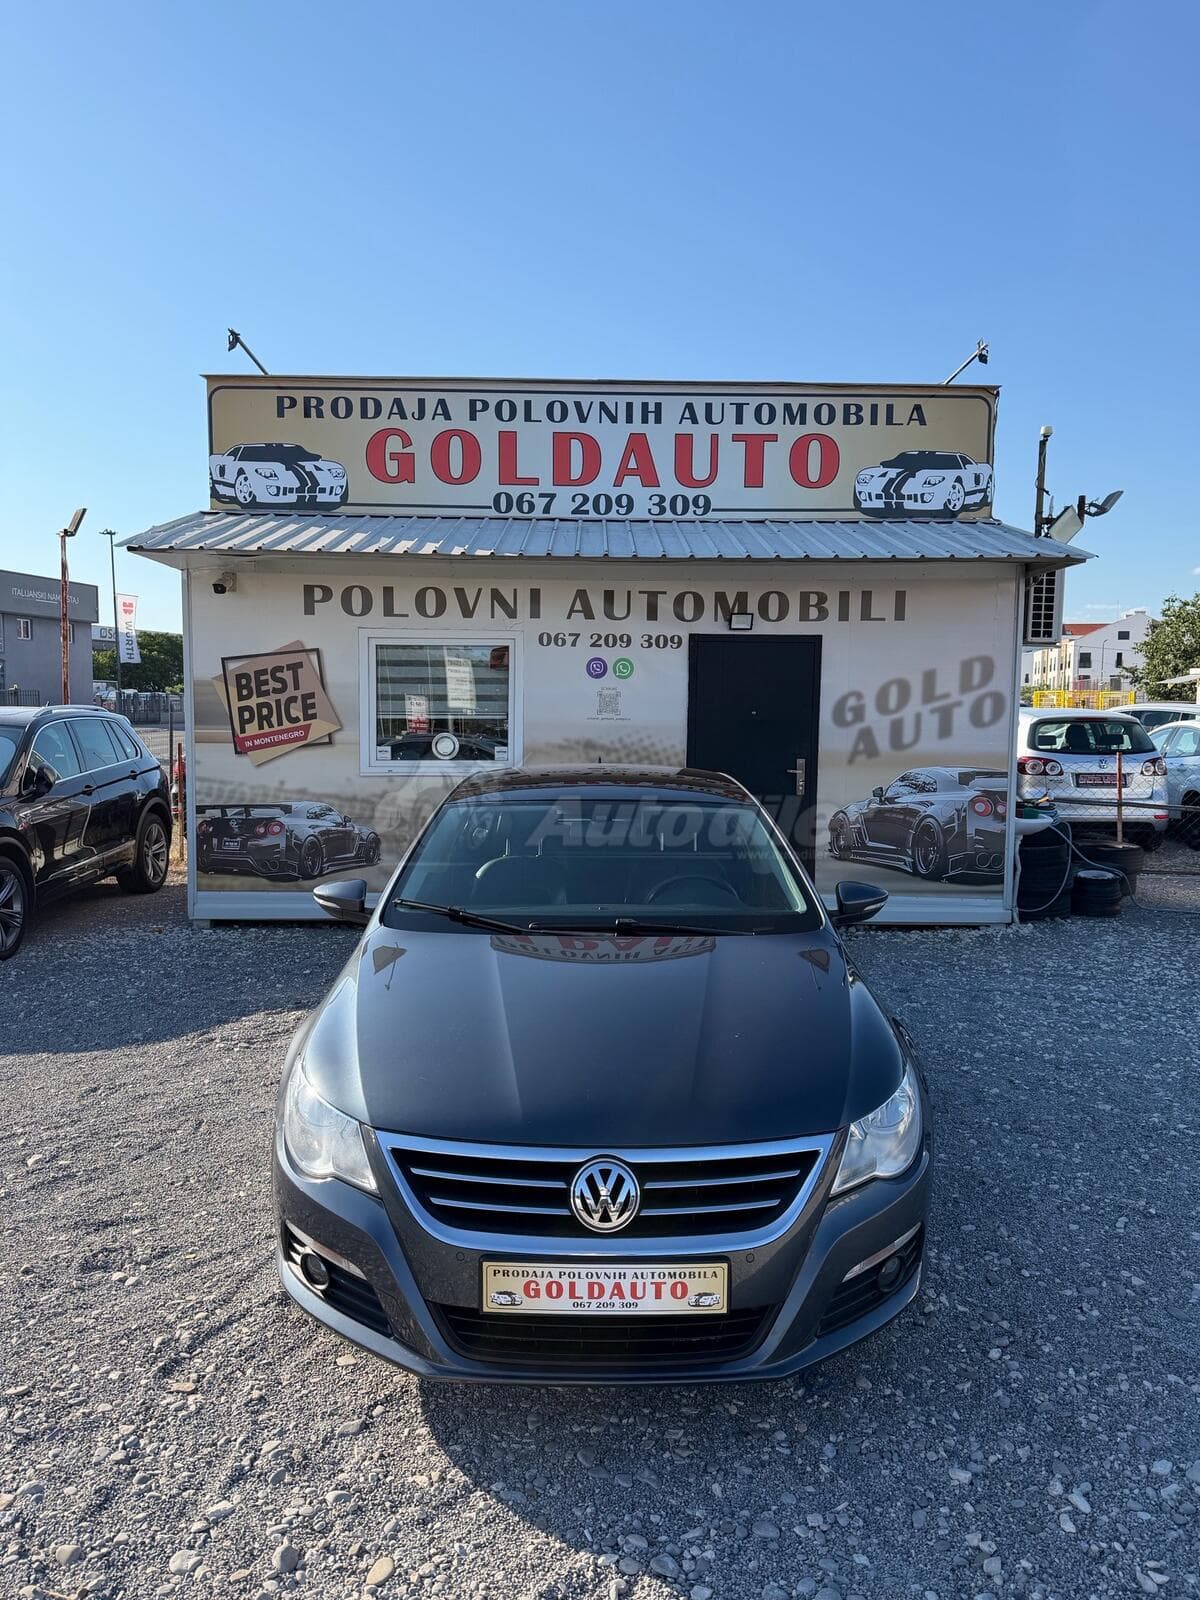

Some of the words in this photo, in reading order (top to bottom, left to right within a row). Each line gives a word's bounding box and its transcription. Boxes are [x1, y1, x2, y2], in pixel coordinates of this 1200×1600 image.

[276, 395, 452, 422] PRODAJA
[469, 398, 663, 426] POLOVNIH
[679, 401, 928, 427] AUTOMOBILA
[365, 427, 841, 489] GOLDAUTO
[491, 492, 557, 515] 067
[571, 492, 635, 516] 209
[647, 494, 712, 517] 309
[303, 584, 541, 620] POLOVNI
[566, 588, 907, 623] AUTOMOBILI
[538, 632, 580, 649] 067
[589, 632, 632, 649] 209
[640, 633, 683, 650] 309
[235, 661, 304, 702] BEST
[831, 654, 996, 729] GOLD
[237, 692, 318, 735] PRICE
[846, 690, 1007, 766] AUTO
[245, 740, 253, 748] IN
[254, 730, 305, 746] MONTENEGRO
[493, 1269, 554, 1279] PRODAJA
[558, 1271, 627, 1280] POLOVNIH
[632, 1270, 719, 1280] AUTOMOBILA
[522, 1280, 689, 1300] GOLDAUTO
[572, 1301, 592, 1309] 067
[595, 1301, 616, 1310] 209
[618, 1302, 639, 1310] 309
